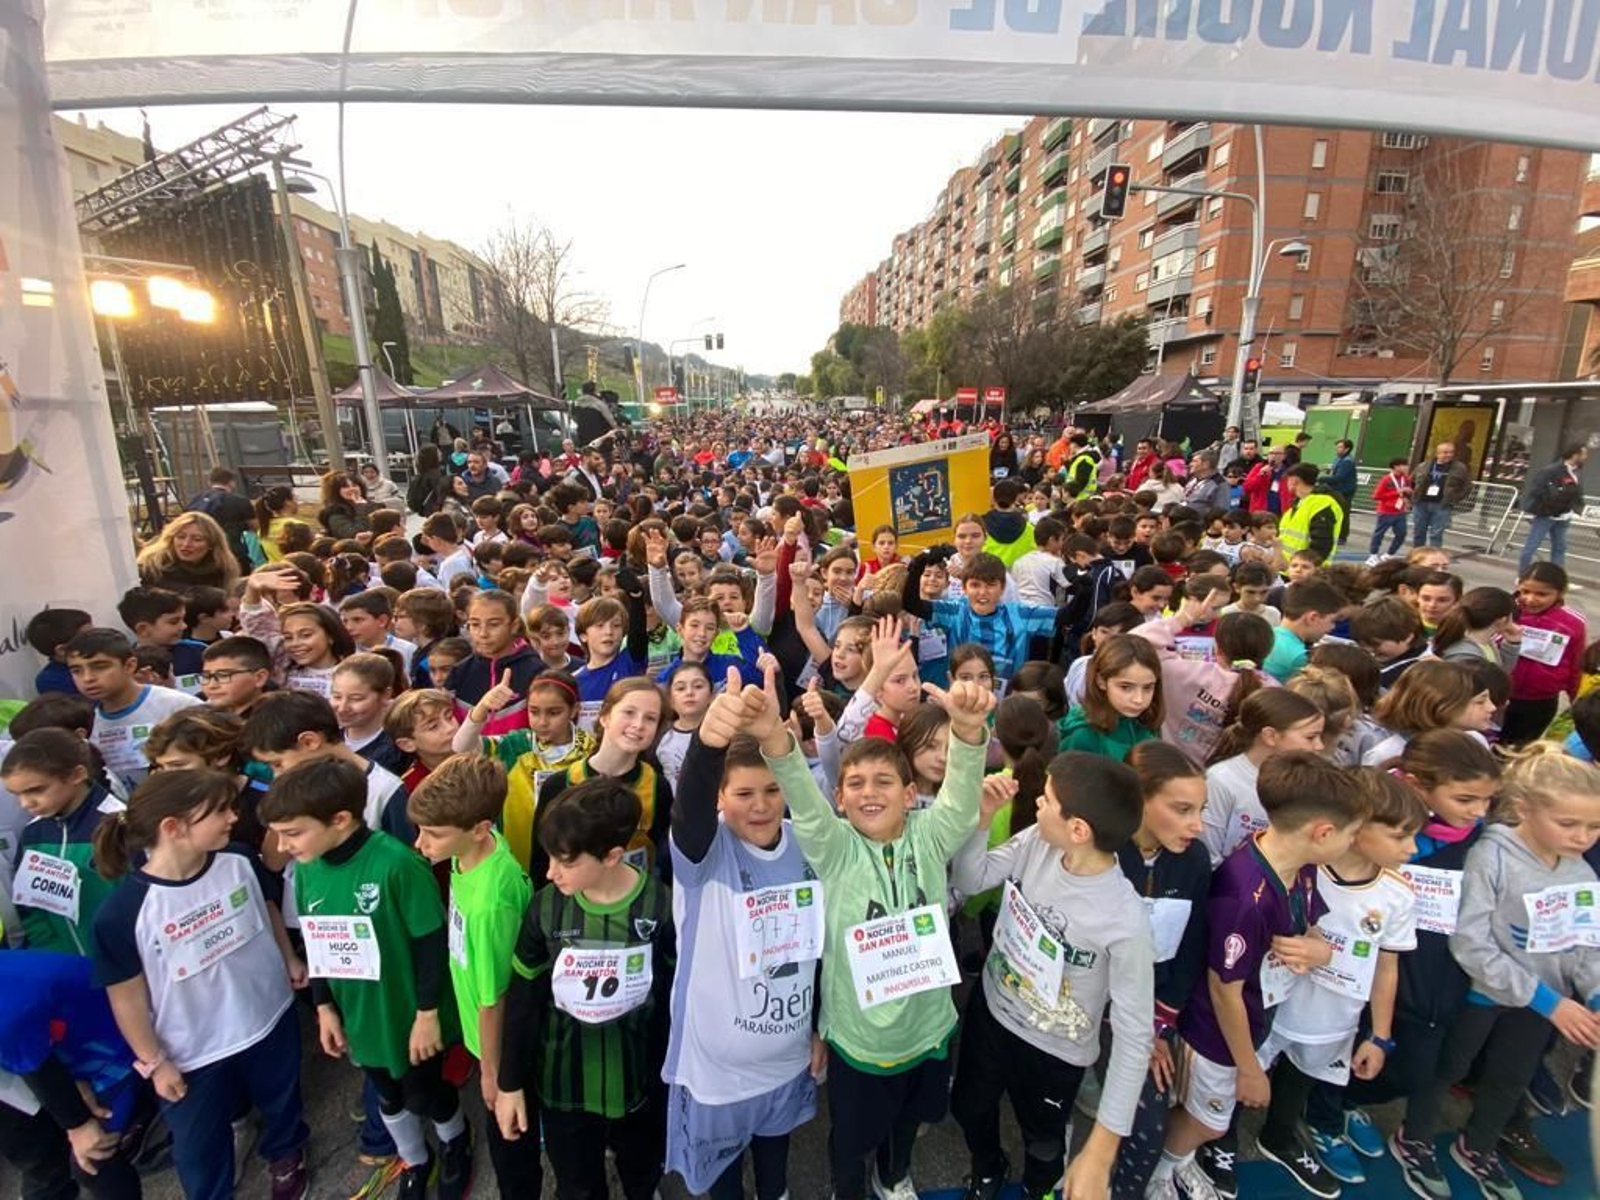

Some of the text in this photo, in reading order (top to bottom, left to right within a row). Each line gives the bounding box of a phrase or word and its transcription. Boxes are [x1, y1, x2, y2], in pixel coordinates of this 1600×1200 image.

[31, 876, 75, 900] CORINA
[203, 926, 234, 949] 8000
[867, 925, 894, 940] NOCHE
[895, 923, 906, 933] DE
[329, 941, 358, 952] HUGO
[858, 941, 877, 954] SAN
[882, 945, 918, 960] MANUEL
[339, 956, 352, 965] 10
[576, 959, 619, 969] NOCHE DE
[564, 969, 583, 977] SAN
[866, 956, 943, 985] MARTÍNEZ CASTRO
[582, 975, 620, 1000] 10
[750, 982, 812, 1023] Jaén
[734, 1015, 783, 1035] PARAÍSO
